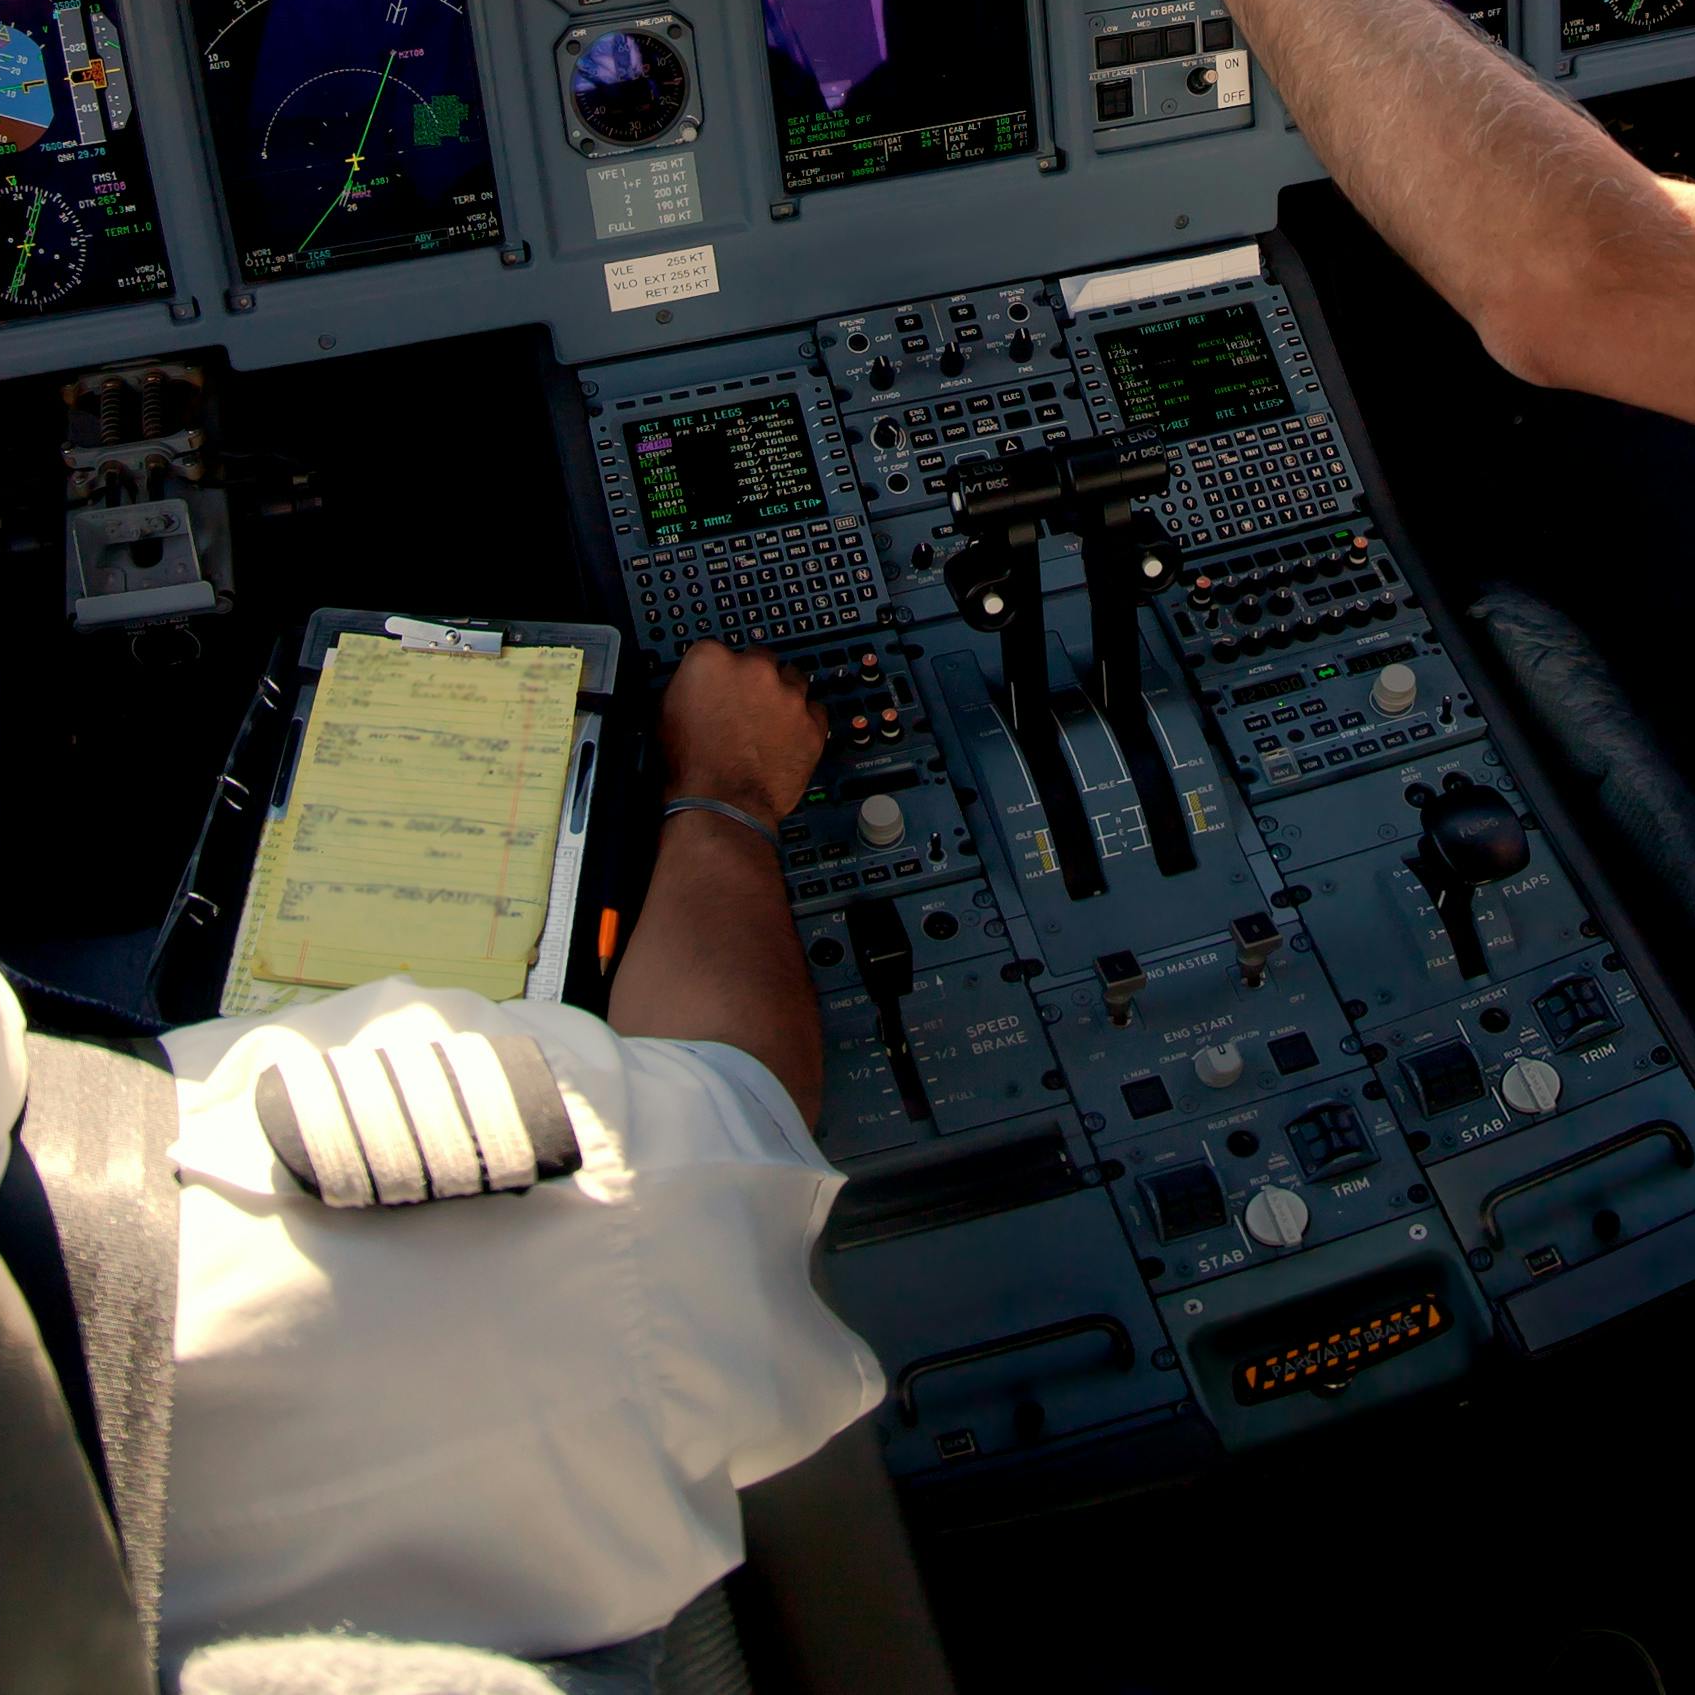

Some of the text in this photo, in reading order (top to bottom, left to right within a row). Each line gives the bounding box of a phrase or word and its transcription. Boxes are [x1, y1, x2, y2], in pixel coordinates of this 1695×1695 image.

[1131, 1, 1196, 20] AUTO BRAKE
[1136, 20, 1152, 28] MED
[209, 61, 230, 70] AUTO
[1224, 58, 1240, 69] ON
[1223, 90, 1246, 103] OFF
[790, 130, 846, 146] NO SMOKING
[650, 158, 684, 172] 250 KT
[92, 172, 117, 183] FMS1
[598, 169, 618, 180] VFE
[623, 171, 686, 190] 1+F 210 KT
[453, 191, 493, 205] TERR ON
[624, 184, 688, 203] 2 200 KT
[627, 198, 690, 216] 3 190 KT
[105, 222, 152, 237] TERM 1.0
[608, 211, 692, 233] FULL 180 KT
[612, 252, 705, 276] VLE 255 KT
[614, 266, 708, 291] VLO EXT 255 KT
[646, 279, 710, 298] RET 215 KT
[1138, 314, 1206, 336] TAKEOFF REF
[1003, 392, 1020, 401] ELEC
[1043, 408, 1056, 416] ALL
[1216, 409, 1235, 420] RTE
[1254, 399, 1279, 413] LEGS
[639, 408, 742, 432] ACT RTE LEGS
[915, 434, 933, 442] FUEL
[1129, 430, 1156, 443] ENG
[920, 456, 942, 465] CLEAR
[1120, 446, 1163, 462] A/T DISC
[965, 478, 1008, 493] A/T DISC
[760, 499, 815, 516] LEGS ETA
[1098, 781, 1116, 790] IDLE
[1208, 823, 1225, 832] MAX
[1026, 871, 1044, 879] MAX
[1503, 874, 1550, 896] FLAPS
[1493, 935, 1514, 945] FULL
[1166, 952, 1218, 974] MASTER
[1427, 958, 1448, 968] FULL
[967, 1016, 1019, 1038] SPEED
[1164, 1015, 1234, 1043] ENG START
[972, 1031, 1028, 1054] BRAKE
[1581, 1044, 1616, 1065] TRIM
[1208, 1110, 1259, 1130] RUD RESET
[1462, 1118, 1504, 1143] STAB
[1331, 1177, 1370, 1198] TRIM
[1199, 1249, 1244, 1272] STAB
[1272, 1314, 1415, 1378] PARK/ALTN BRAKE
